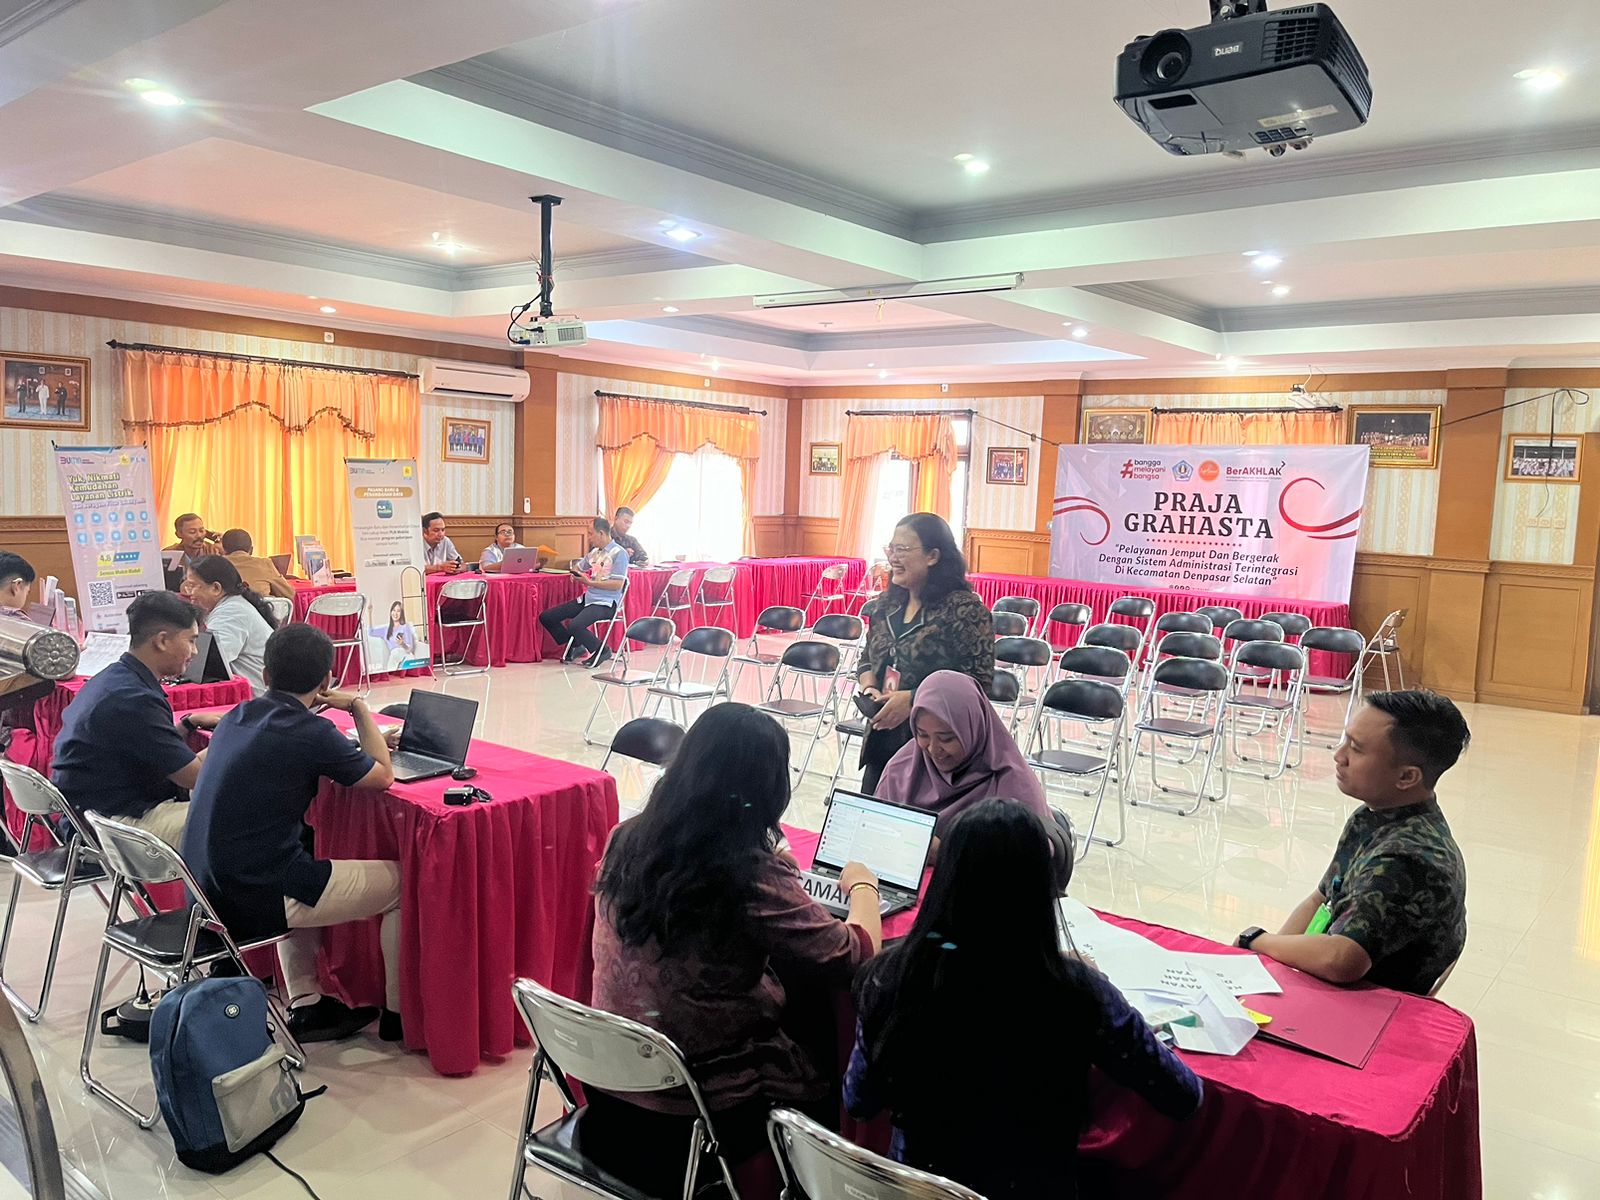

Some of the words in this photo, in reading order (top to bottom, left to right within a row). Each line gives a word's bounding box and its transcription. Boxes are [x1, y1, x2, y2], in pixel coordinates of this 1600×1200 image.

[1134, 459, 1161, 468] bangga
[87, 472, 120, 482] Nikmati
[1134, 466, 1166, 475] melayani
[1134, 473, 1160, 481] bangsa
[1226, 466, 1283, 477] BerAKHLAK
[69, 482, 118, 492] Kemudahan
[70, 492, 105, 502] Layanan
[107, 489, 134, 499] Listrik
[1153, 491, 1243, 514] PRAJA
[1124, 512, 1274, 539] GRAHASTA
[1170, 548, 1206, 560] Jemput
[1208, 550, 1230, 560] Dan
[1232, 551, 1280, 564] Bergerak
[1099, 554, 1133, 566] Dengan
[1135, 557, 1167, 567] Sistem
[1169, 559, 1232, 572] Administrasi
[1235, 563, 1299, 577] Terintegrasi
[1115, 565, 1125, 574] Di
[1127, 567, 1181, 579] Kecamatan
[1183, 571, 1231, 584] Denpasar
[798, 876, 850, 904] AMA
